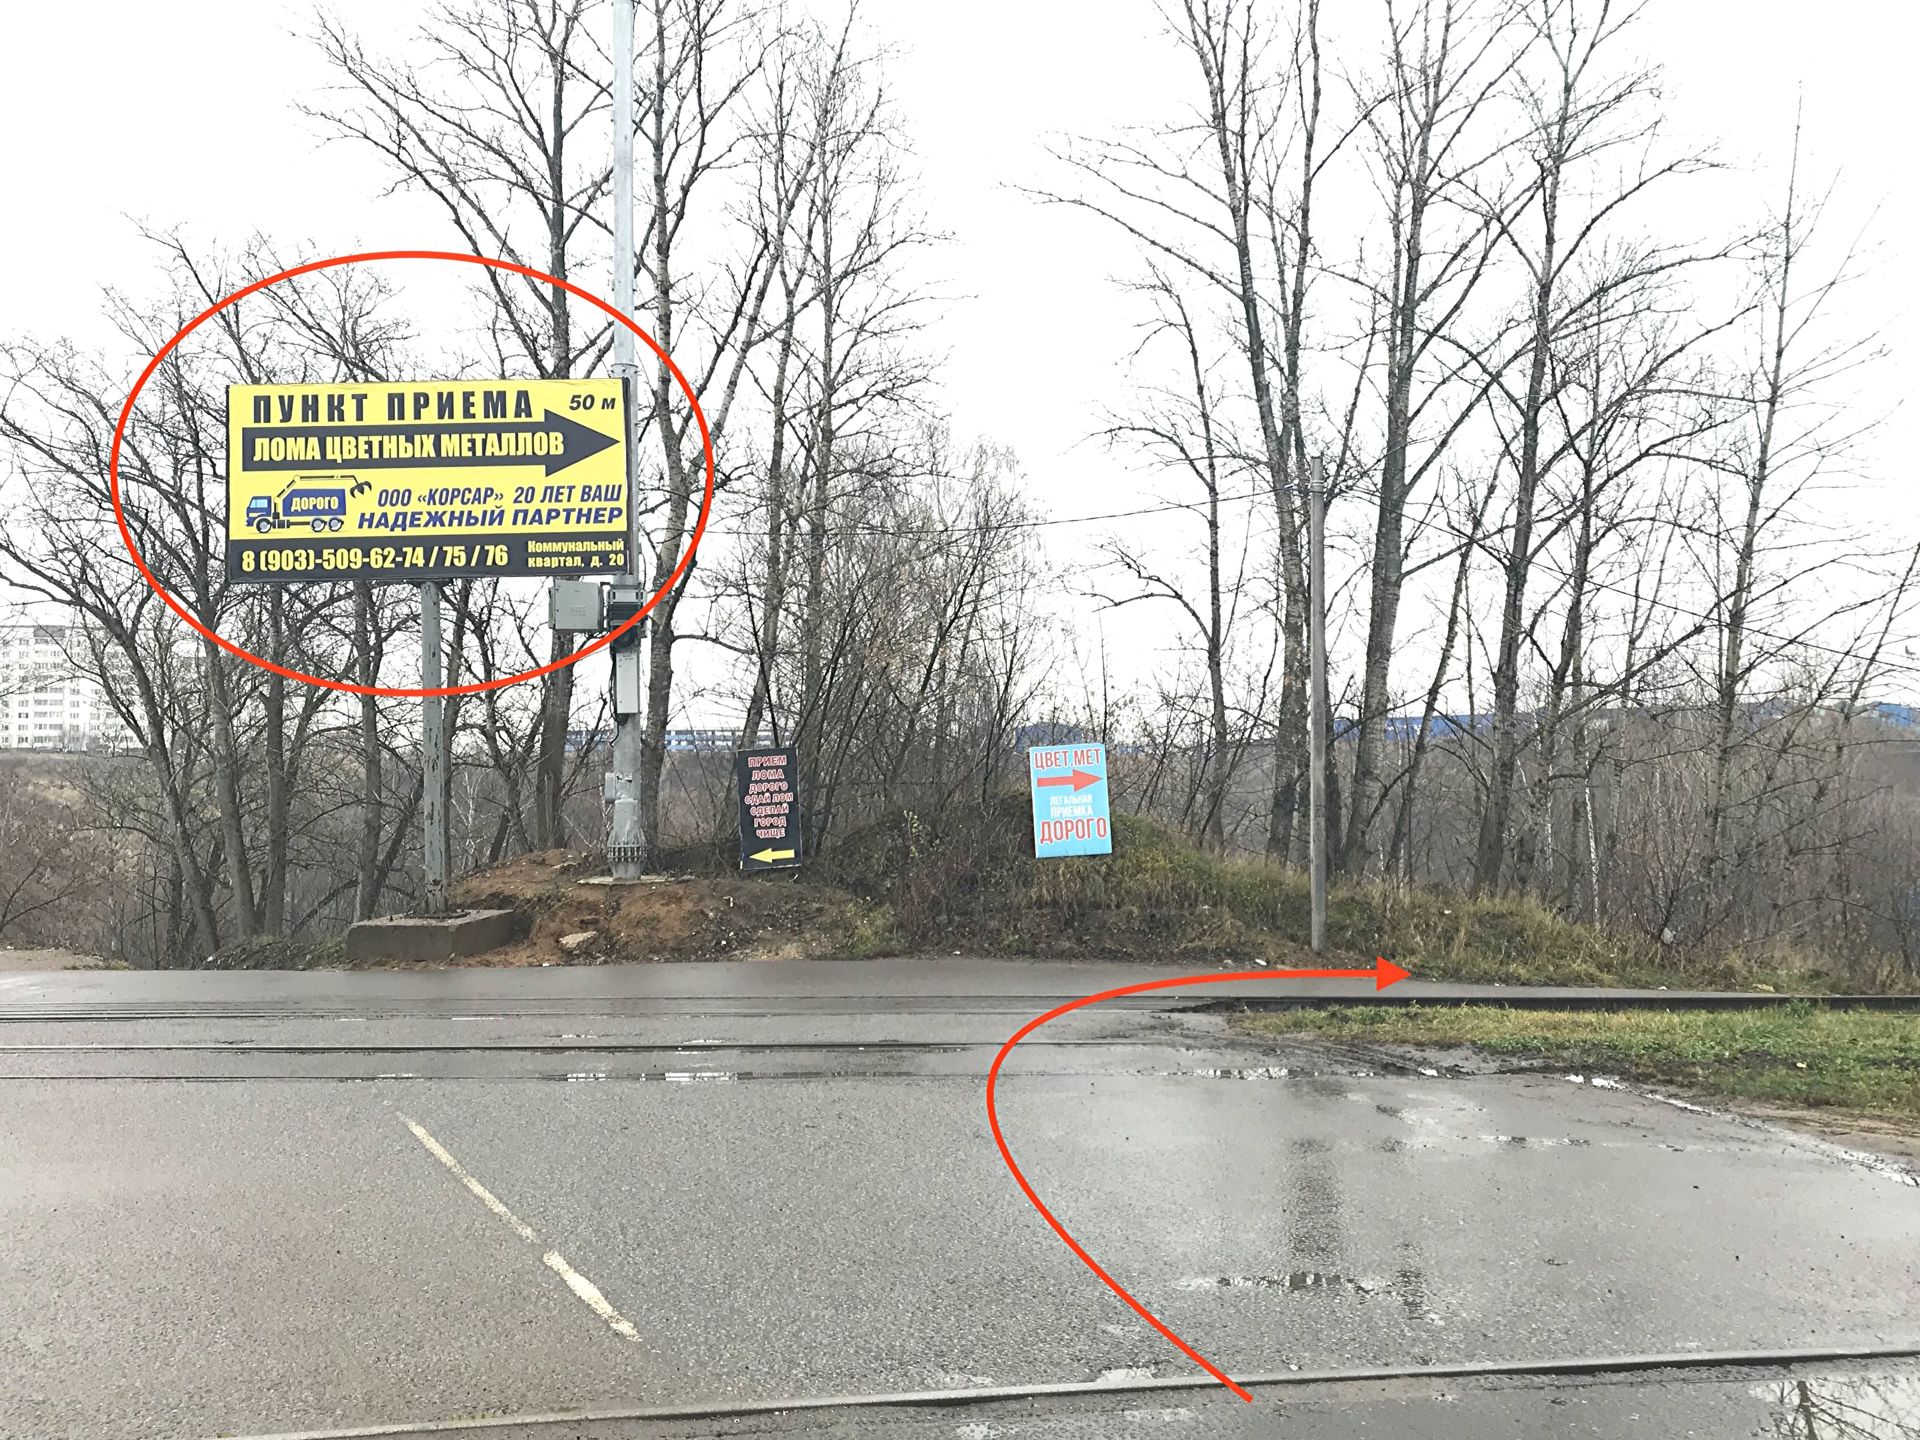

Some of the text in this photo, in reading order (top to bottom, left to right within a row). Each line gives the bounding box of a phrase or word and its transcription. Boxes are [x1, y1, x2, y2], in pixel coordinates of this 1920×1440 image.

[253, 390, 532, 423] ПУНКТ ПРИЕМА
[569, 394, 595, 411] 50
[253, 431, 564, 463] ЛОМА ЦВЕТНЫХ МЕТАЛЛОВ
[377, 484, 622, 507] ООО «КОРСАР» 20 ЛЕТ ВАШ
[290, 496, 339, 512] ДОРОГО
[357, 505, 623, 532] НАДЕЖНЫЙ ПАРТНЕР
[527, 538, 625, 553] Коммунальный
[241, 550, 256, 572] 8
[442, 545, 467, 567] 75
[484, 544, 509, 566] 76
[527, 553, 625, 568] квартал, д. 20
[748, 755, 787, 768] ПРИЕМ
[752, 769, 785, 781] ЛОМА
[749, 781, 788, 794] ДОРОГО
[744, 792, 793, 805] СДАЙ ЛОМ
[750, 803, 789, 817] СДЕЛАЙ
[1050, 804, 1094, 818] ПРИЕМКА
[754, 816, 787, 828] ГОРОД
[756, 827, 785, 839] ЧИЩЕ
[1040, 817, 1107, 845] ДОРОГО
